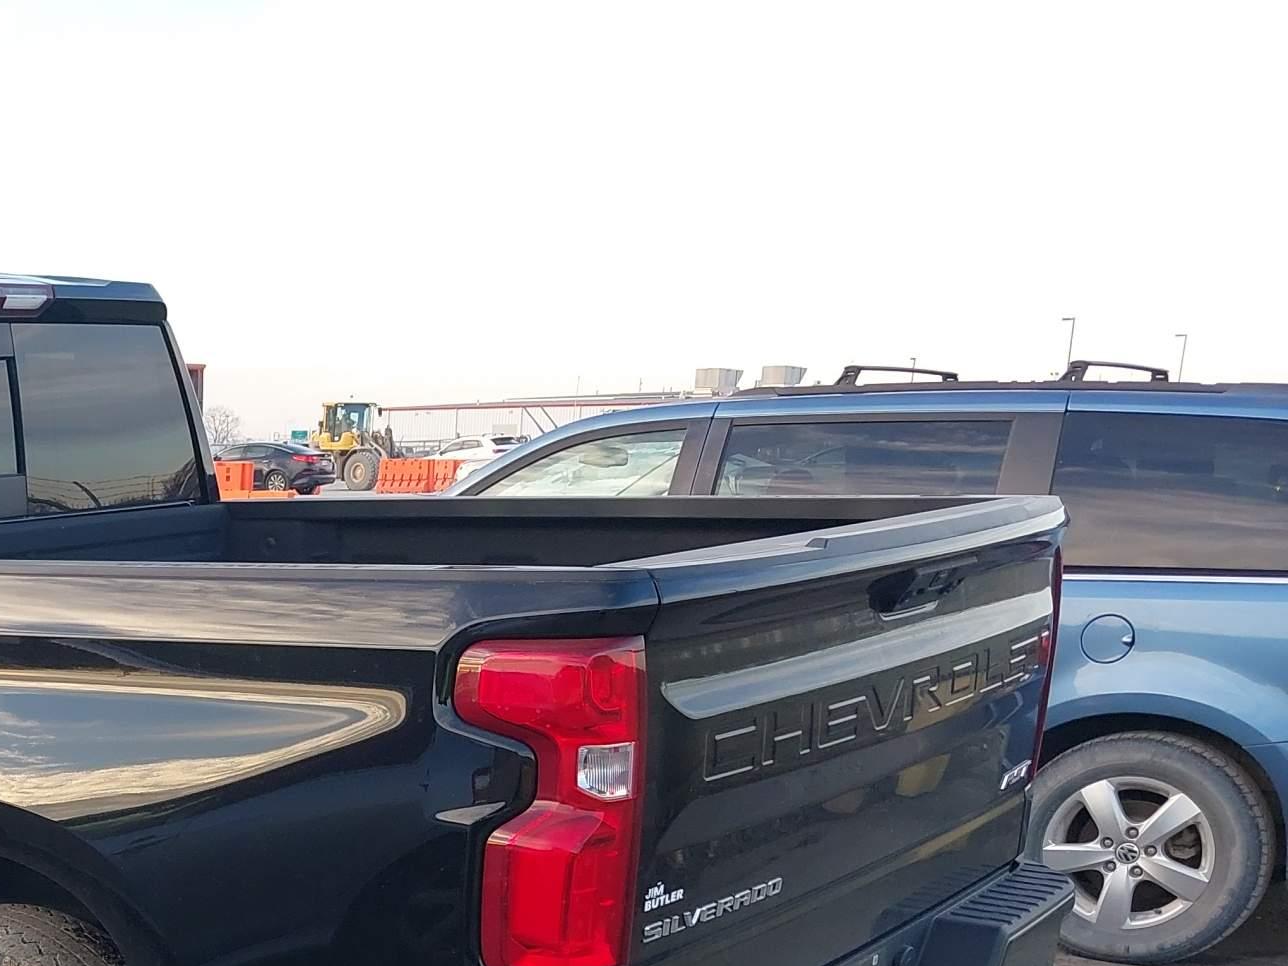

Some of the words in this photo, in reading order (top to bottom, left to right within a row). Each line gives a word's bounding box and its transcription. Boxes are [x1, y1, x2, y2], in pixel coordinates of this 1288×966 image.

[643, 888, 684, 912] BUTLER
[644, 883, 665, 900] JIM
[642, 877, 783, 943] SILVERADO
